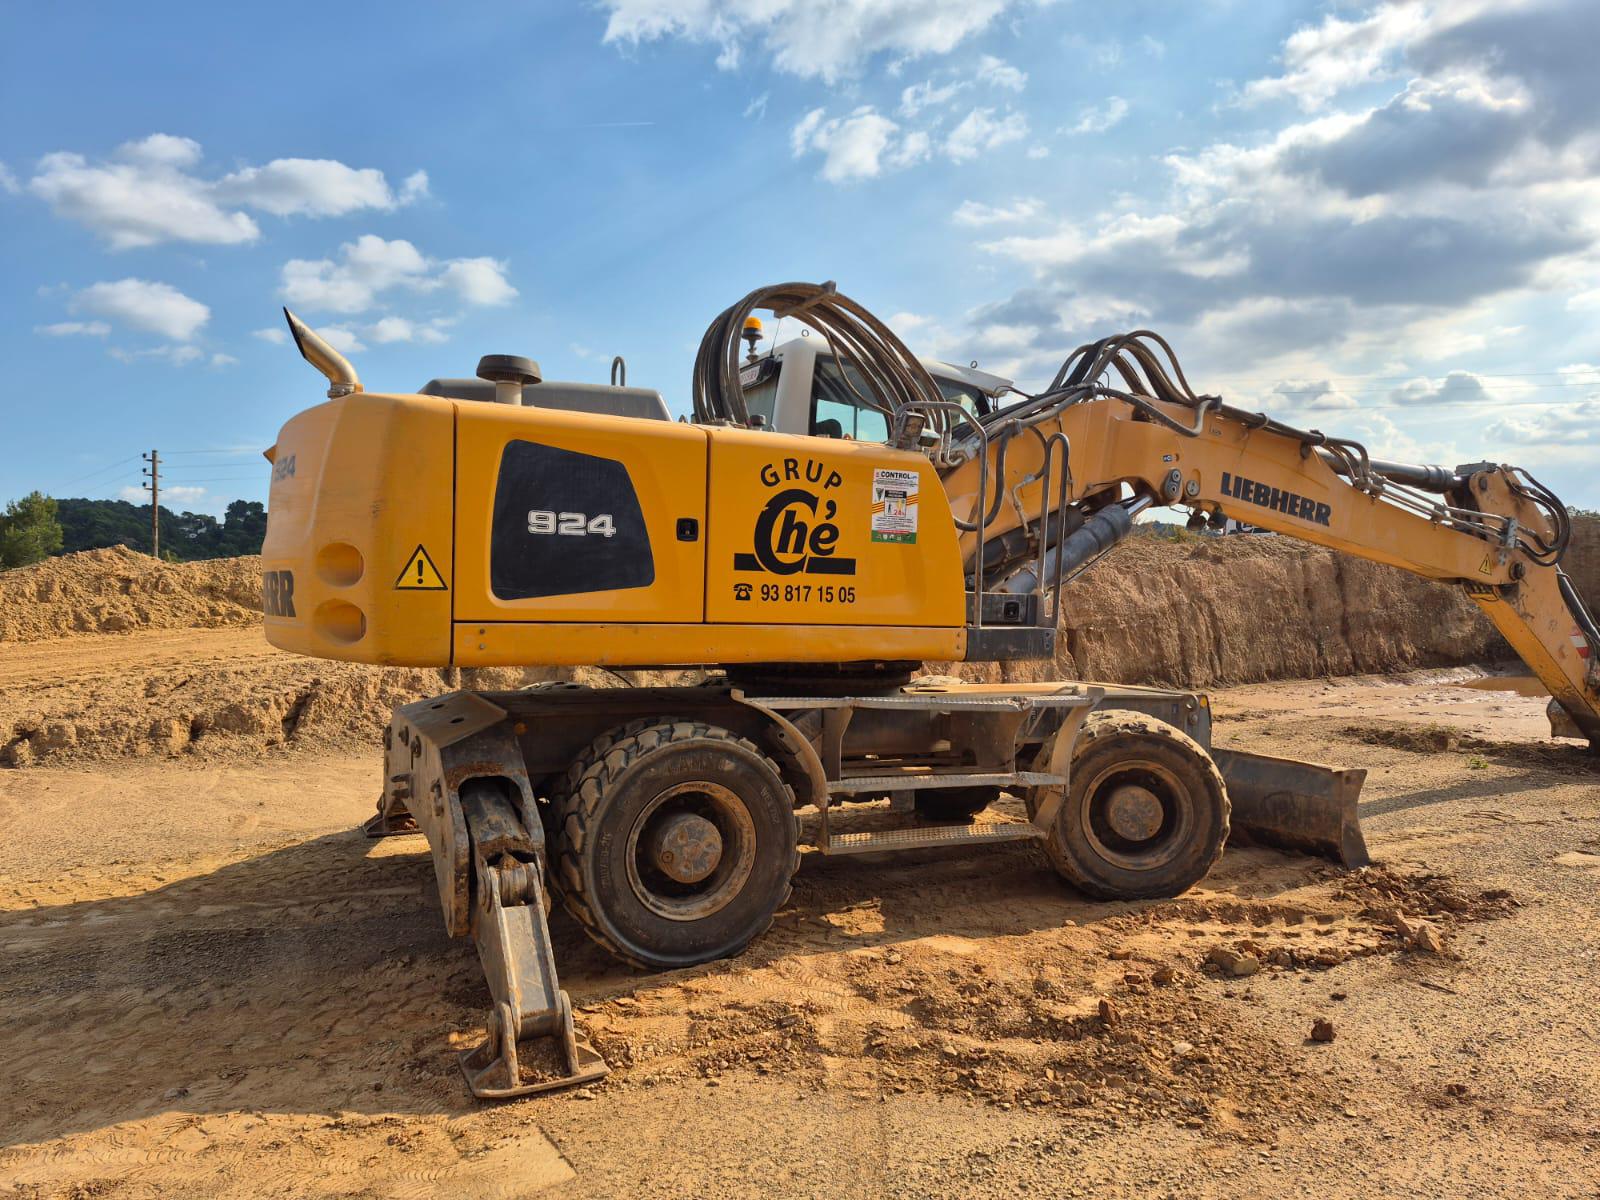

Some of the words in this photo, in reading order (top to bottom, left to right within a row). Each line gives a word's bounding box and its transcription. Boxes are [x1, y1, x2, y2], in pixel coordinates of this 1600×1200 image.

[760, 458, 842, 490] GRUP
[880, 471, 911, 480] CONTROL
[1220, 471, 1332, 527] LIEBHERR
[527, 509, 617, 538] 924
[761, 583, 779, 602] 93
[784, 584, 812, 603] 817
[817, 585, 834, 603] 15
[838, 586, 856, 604] 05
